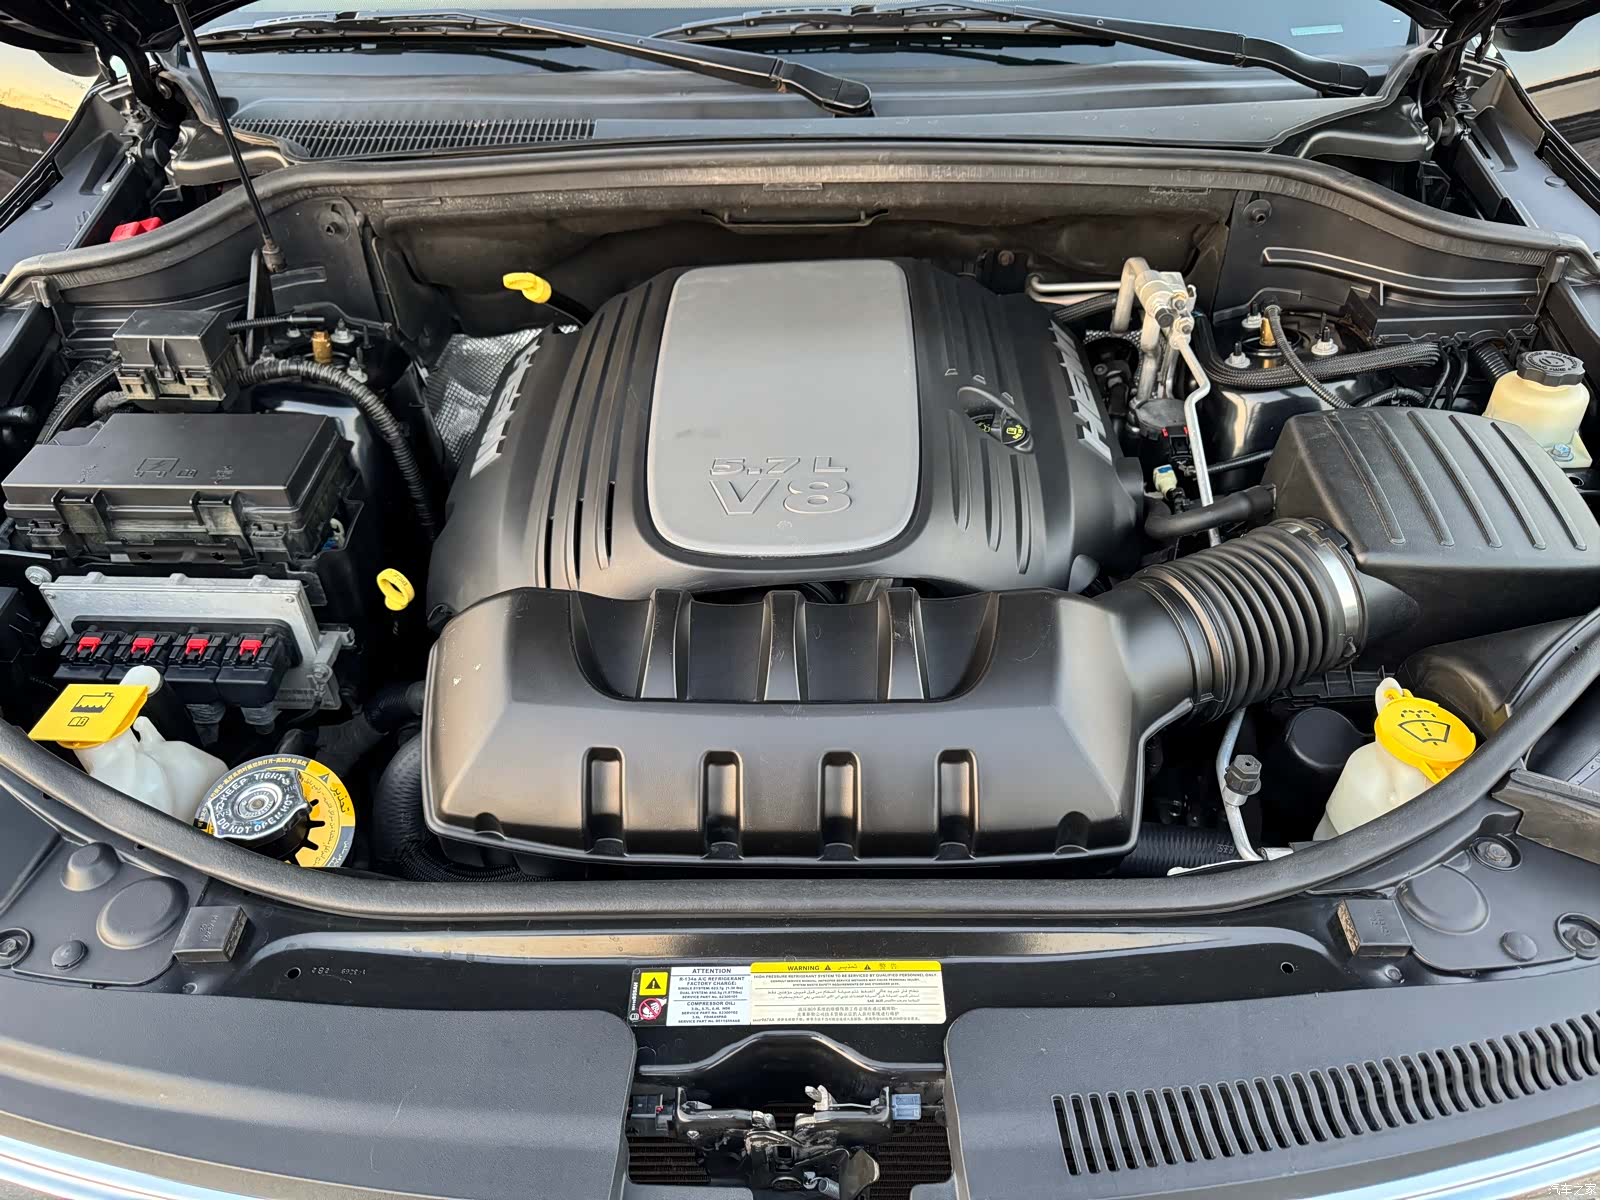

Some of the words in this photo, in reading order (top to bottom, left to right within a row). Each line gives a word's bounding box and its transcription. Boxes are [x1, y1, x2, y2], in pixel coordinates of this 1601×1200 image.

[469, 337, 542, 480] HEMI
[1048, 319, 1113, 467] HEMI
[709, 478, 853, 516] V8
[222, 778, 247, 801] KEEP
[254, 772, 286, 782] TIGHT
[329, 786, 350, 813] تحذير
[217, 818, 230, 830] DO
[229, 825, 252, 834] NOT
[254, 811, 284, 832] OPEN
[281, 794, 295, 813] HOT
